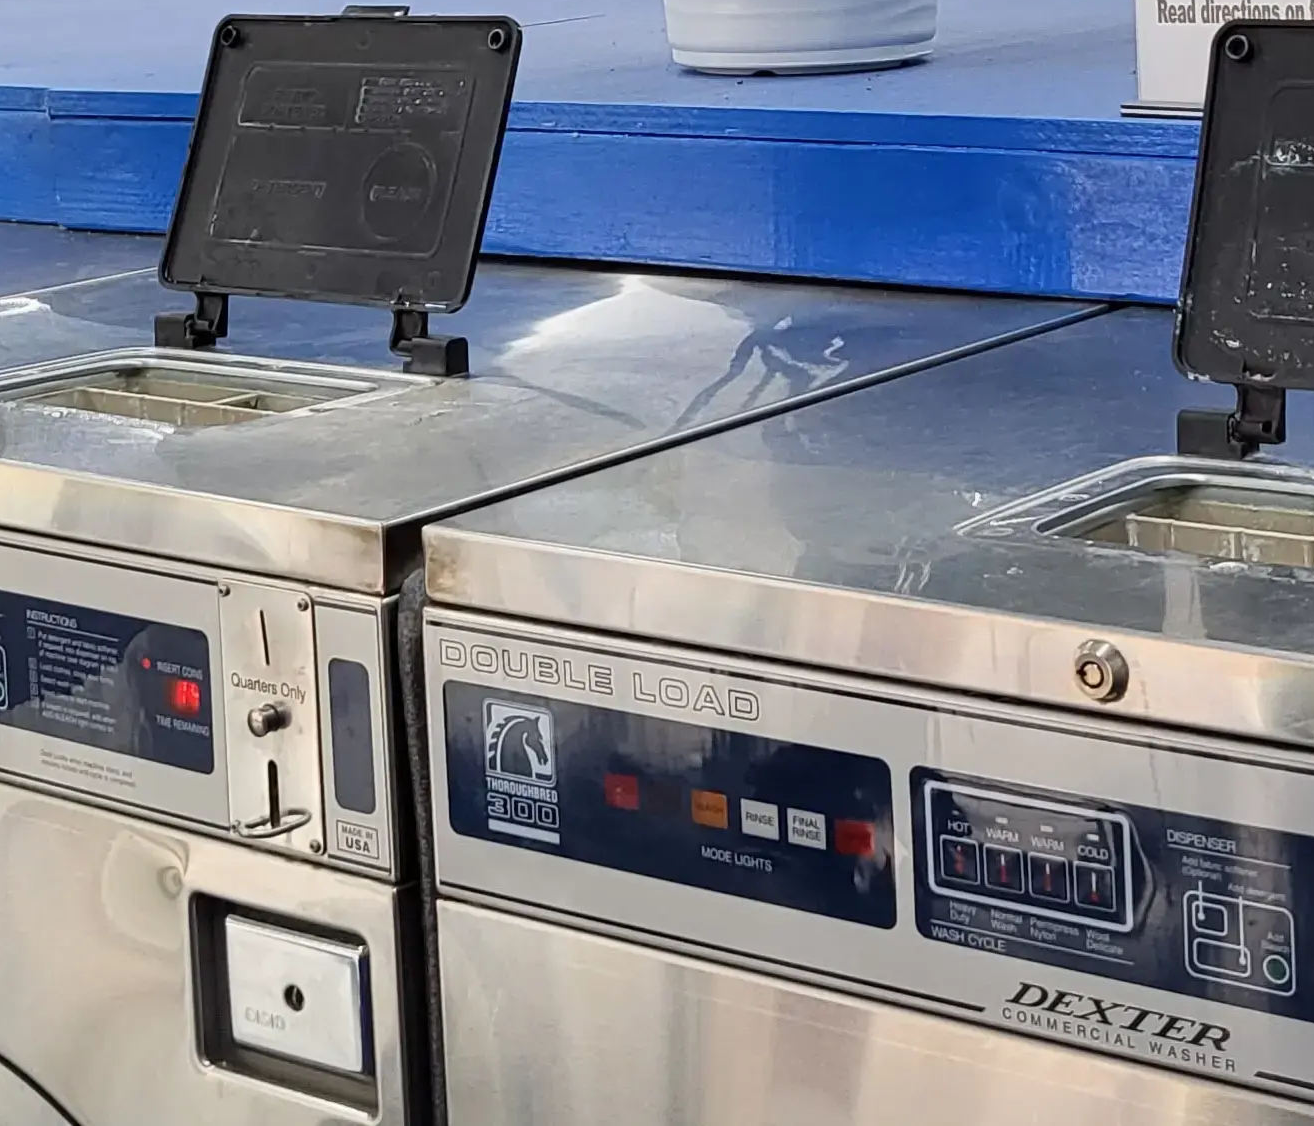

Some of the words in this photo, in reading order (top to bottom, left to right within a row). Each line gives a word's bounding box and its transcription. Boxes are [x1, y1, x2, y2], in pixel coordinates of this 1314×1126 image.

[1285, 1, 1305, 20] on
[231, 672, 278, 695] Quarters
[280, 682, 306, 704] Only
[439, 638, 614, 695] DOUBLE
[633, 672, 760, 721] LOAD
[486, 776, 558, 803] THOROUGHBRED
[488, 793, 559, 828] 300
[745, 811, 775, 827] RINSE
[792, 815, 820, 830] FINAL
[341, 825, 361, 837] MADE
[363, 829, 373, 839] IN
[345, 837, 371, 853] USA
[792, 827, 821, 842] RINSE
[947, 819, 969, 833] HOT
[986, 827, 1019, 843] WARM
[1030, 836, 1065, 851] WARM
[1077, 845, 1109, 860] COLD
[1166, 829, 1237, 854] DISPENSER
[701, 845, 732, 864] MODE
[734, 852, 773, 873] LIGHTS
[931, 926, 965, 942] WASH
[967, 932, 1007, 952] CYCLE
[1030, 926, 1057, 942] Nylon
[1005, 982, 1231, 1052] DEXTER
[1002, 1007, 1136, 1049] COMMERCIAL
[1149, 1041, 1236, 1073] WASHER
